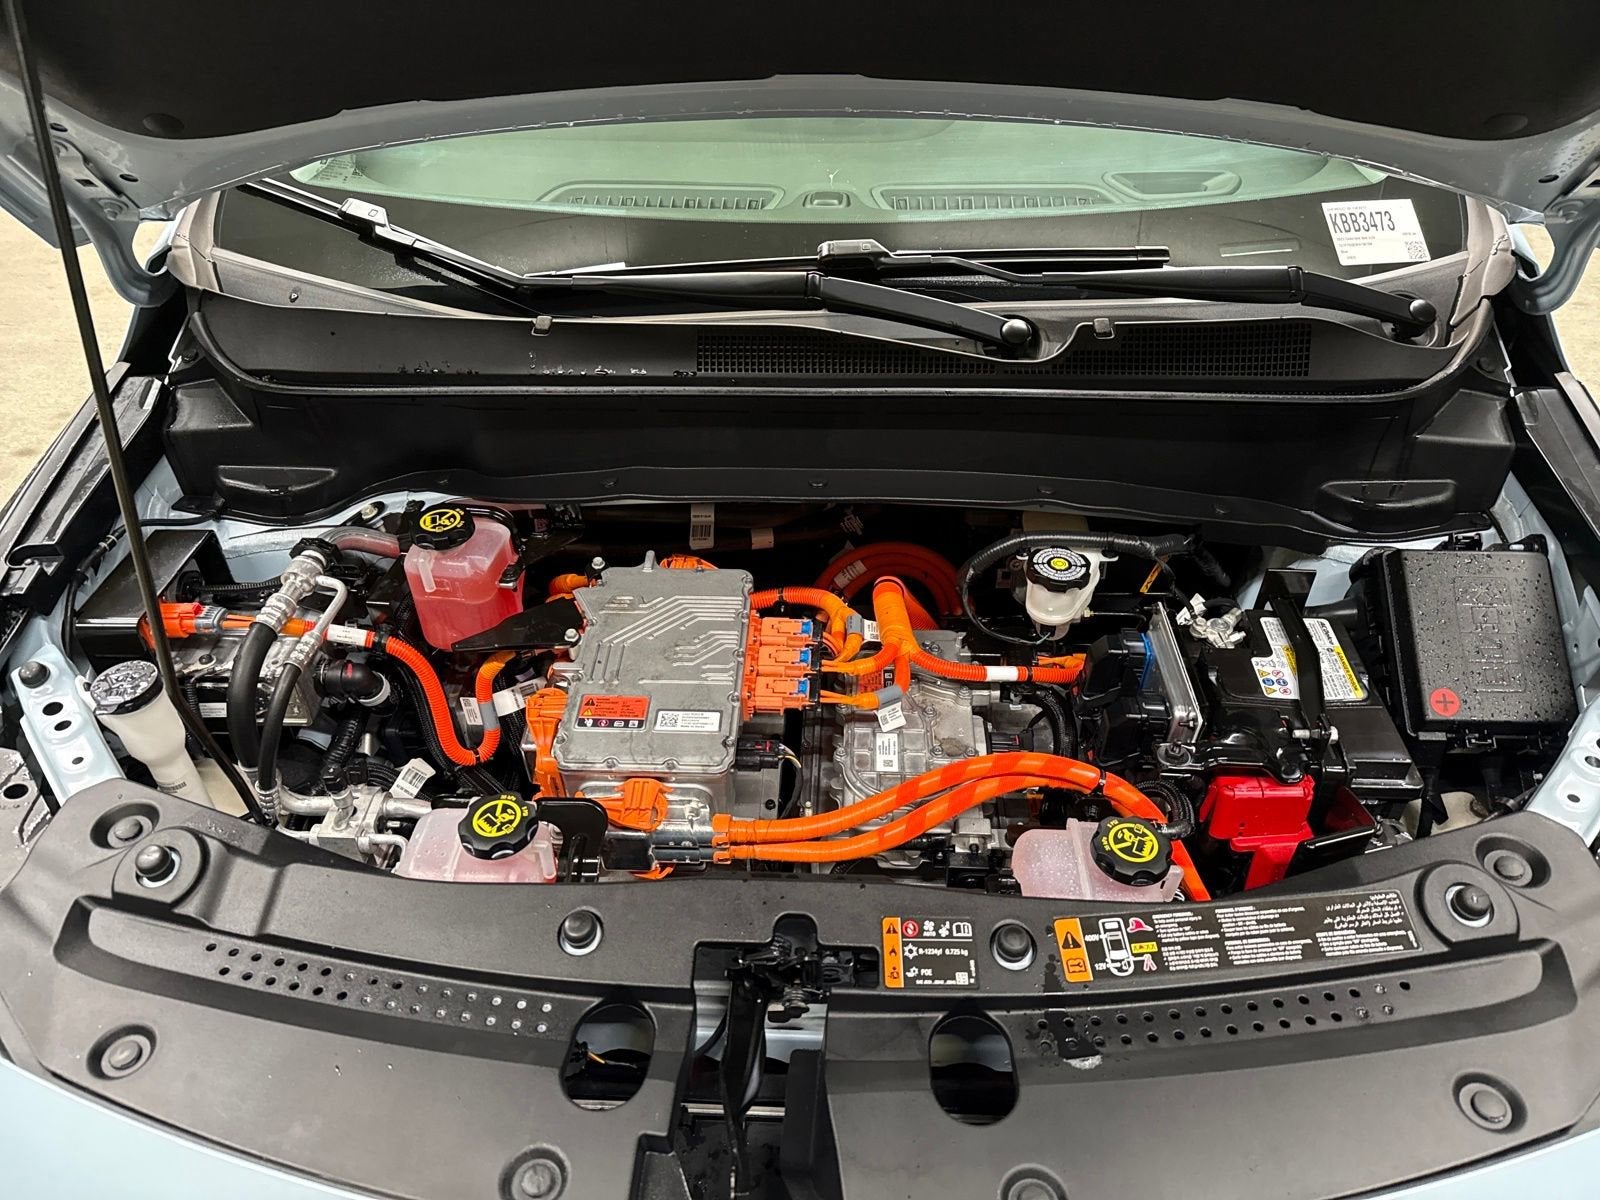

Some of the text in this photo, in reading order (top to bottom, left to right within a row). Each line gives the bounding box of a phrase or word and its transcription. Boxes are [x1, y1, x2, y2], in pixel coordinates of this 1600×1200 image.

[1329, 210, 1395, 234] KBB3473
[1084, 933, 1100, 942] 400V
[944, 948, 961, 956] 0.725
[961, 949, 969, 958] kg
[1094, 962, 1107, 971] 12V
